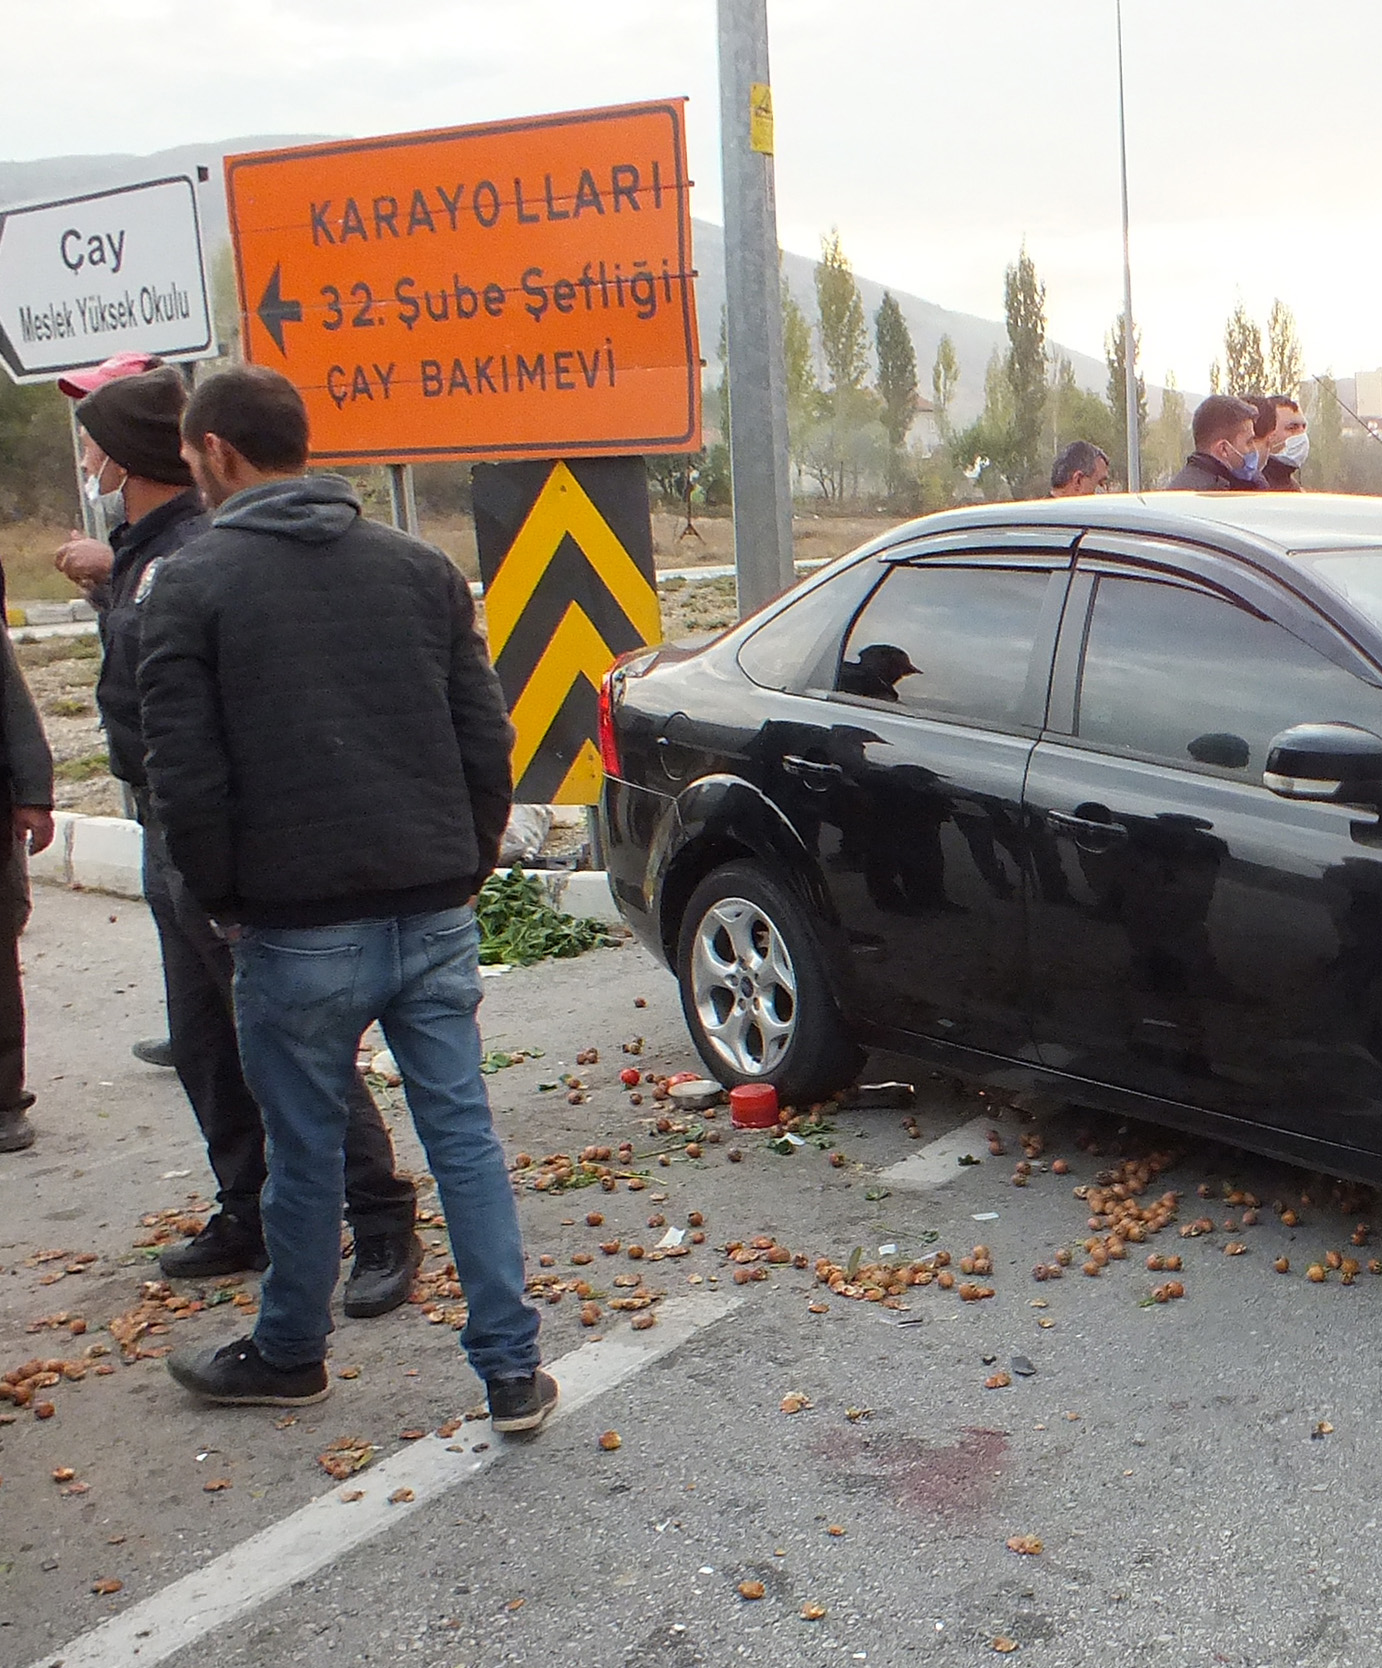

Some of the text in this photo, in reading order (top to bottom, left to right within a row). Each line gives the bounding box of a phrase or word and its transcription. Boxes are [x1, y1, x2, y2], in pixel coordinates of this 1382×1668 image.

[310, 161, 663, 247] KARAYOLLARI
[60, 228, 126, 275] Çay
[18, 281, 191, 343] Meslek Yüksek Okulu
[320, 259, 675, 331] 32. Şube Şefliği
[327, 337, 615, 411] ÇAY BAKIMEVİ
